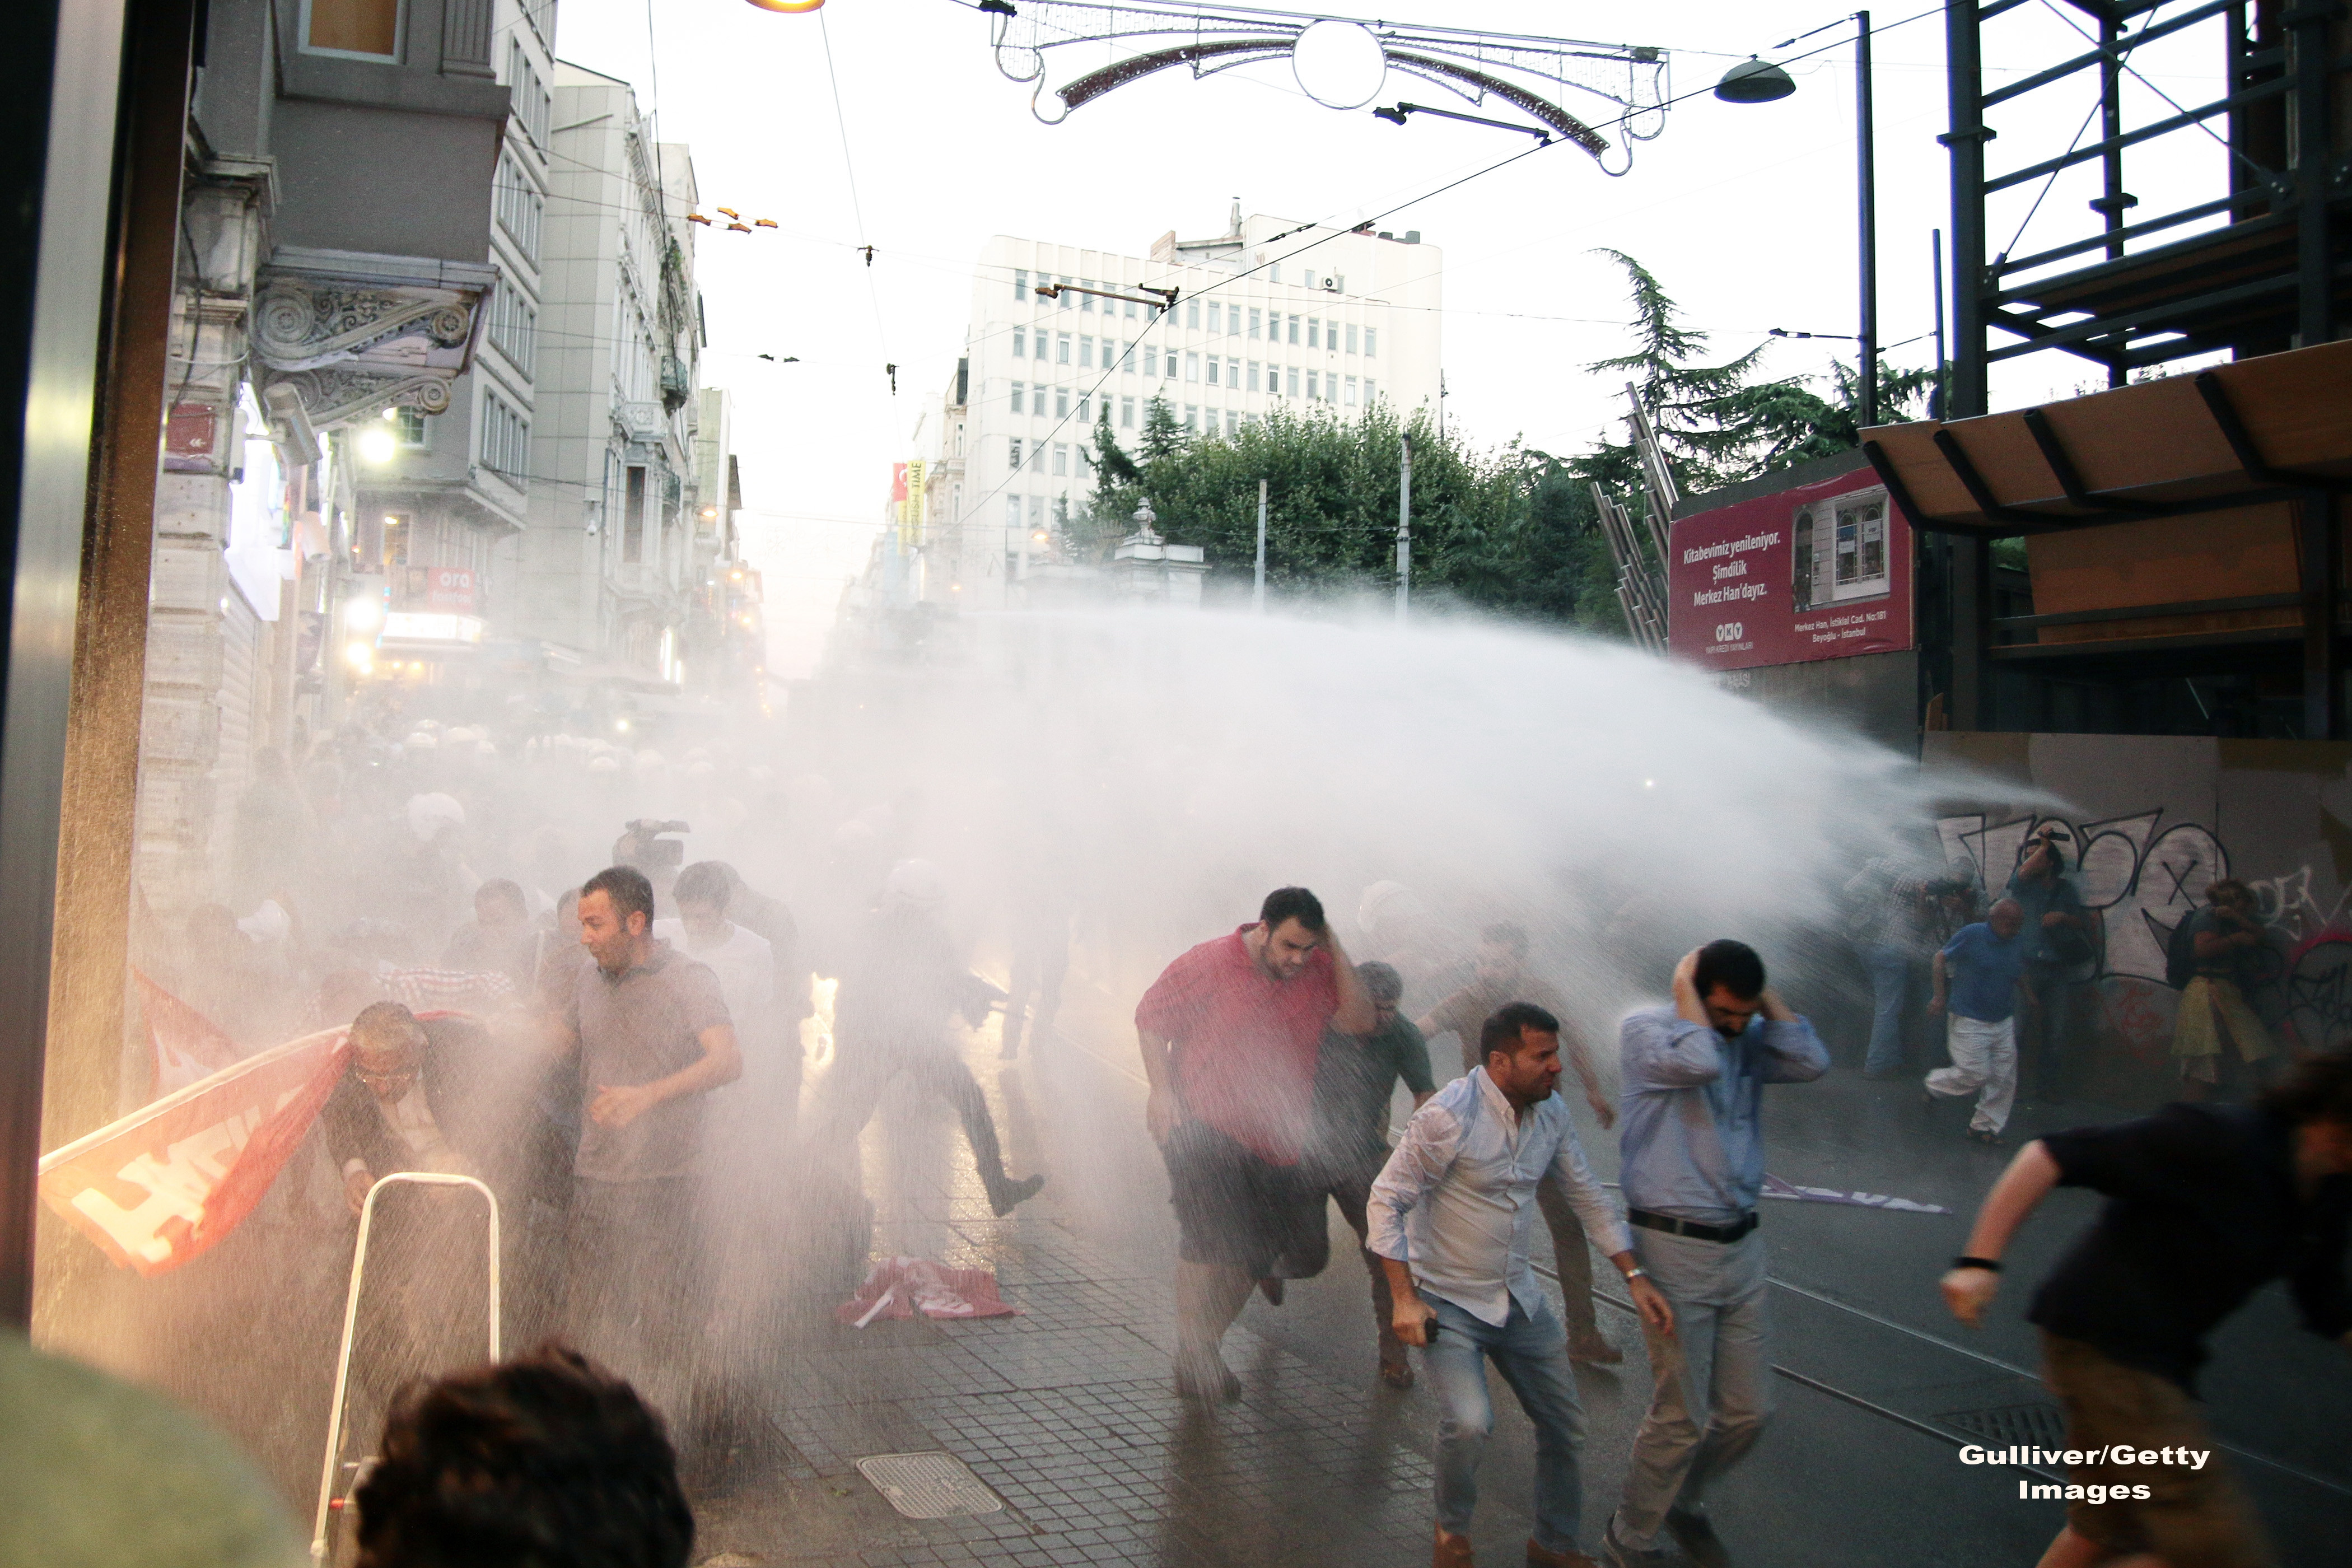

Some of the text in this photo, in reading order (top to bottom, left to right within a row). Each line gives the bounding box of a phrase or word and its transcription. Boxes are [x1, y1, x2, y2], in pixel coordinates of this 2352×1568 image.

[912, 463, 922, 488] TIME
[1684, 531, 1780, 564] Kitabevimiz yenileniyor.
[440, 572, 470, 588] ora
[1712, 560, 1747, 585] Şimdilik
[1694, 583, 1767, 606] Merkez Han'dayız.
[1795, 622, 1815, 632] Merkez
[1816, 621, 1829, 629] Han,
[1850, 614, 1865, 624] Cad.
[1812, 632, 1836, 643] Beyoğlu
[1841, 627, 1866, 638] İstanbul
